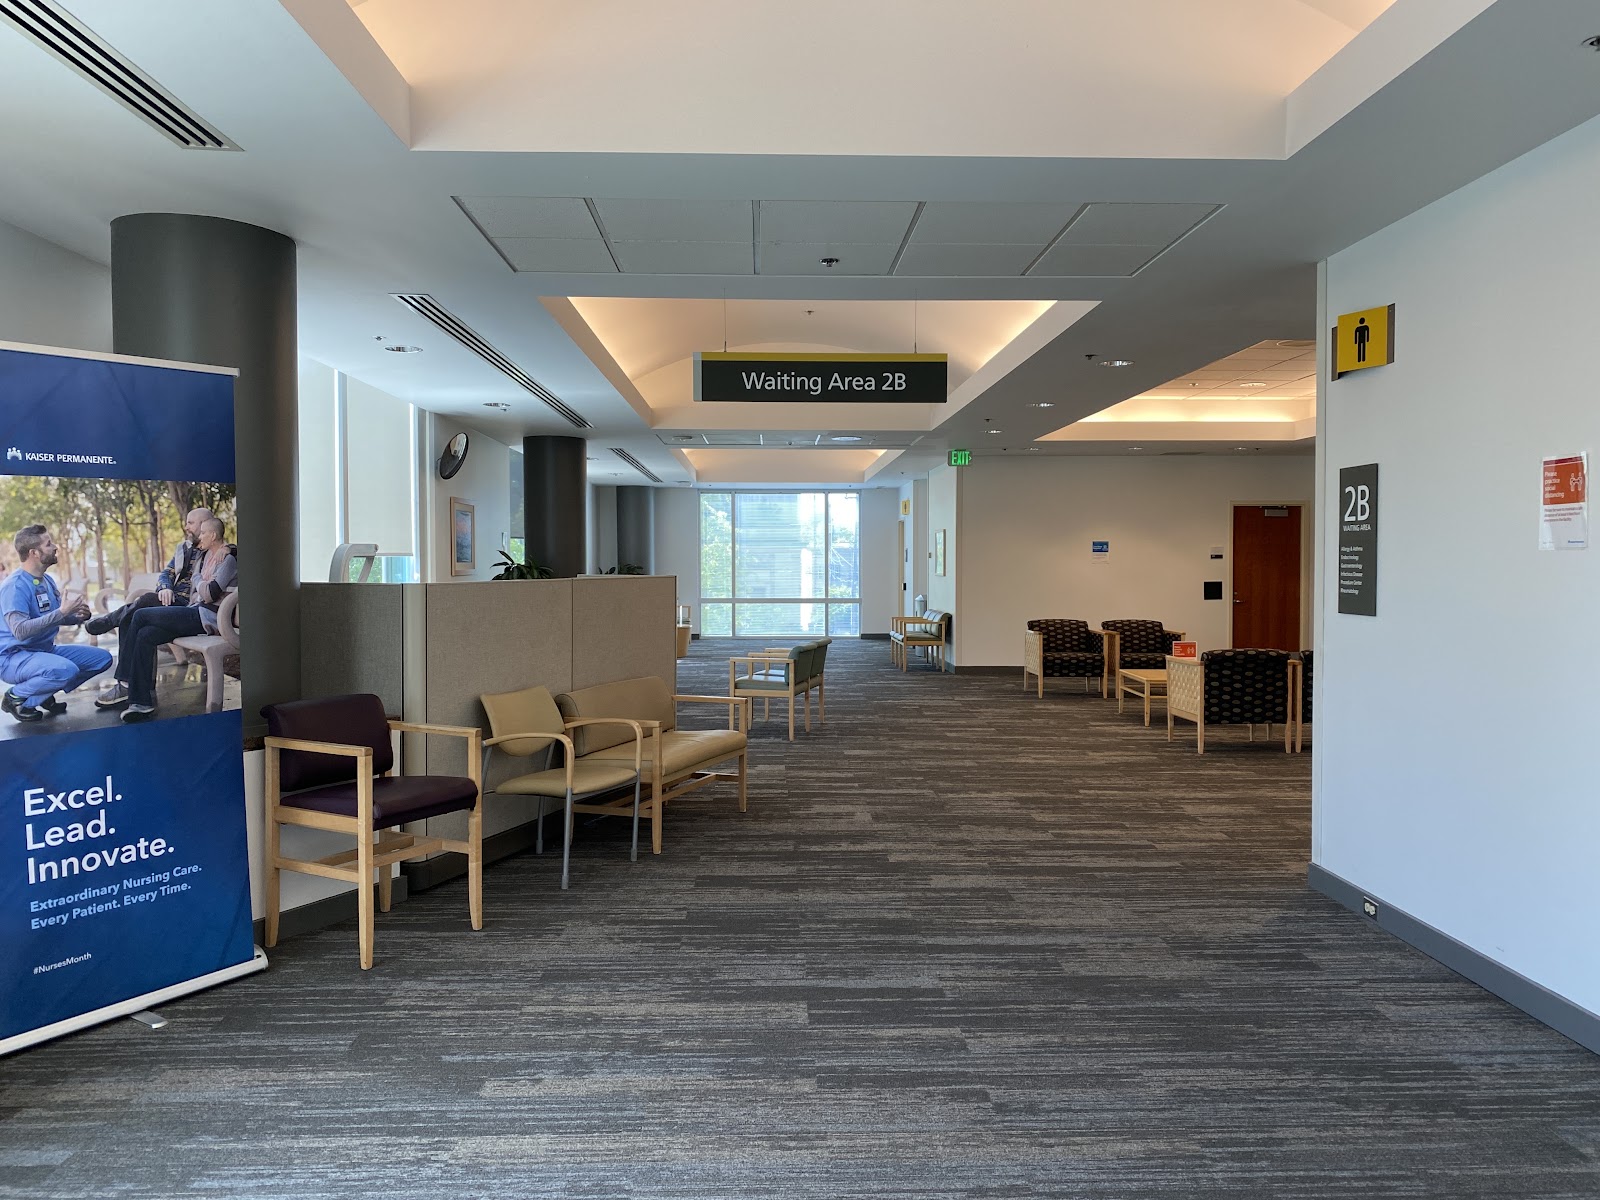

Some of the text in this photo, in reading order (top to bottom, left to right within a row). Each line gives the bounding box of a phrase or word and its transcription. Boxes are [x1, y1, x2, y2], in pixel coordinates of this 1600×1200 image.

[741, 371, 907, 395] Waiting Area 2B
[25, 452, 114, 465] KAISER PERMANENTE
[951, 450, 970, 466] EXIT
[1344, 484, 1370, 522] 2B
[1342, 523, 1372, 532] WAITING AREA
[23, 775, 123, 817] Excel.
[25, 808, 116, 851] Lead.
[27, 836, 175, 885] Innovate.
[30, 864, 202, 913] Extraordinary Nursing Care.
[30, 881, 192, 930] Every Patient. Every Time.
[33, 952, 92, 975] #NursesMonth
